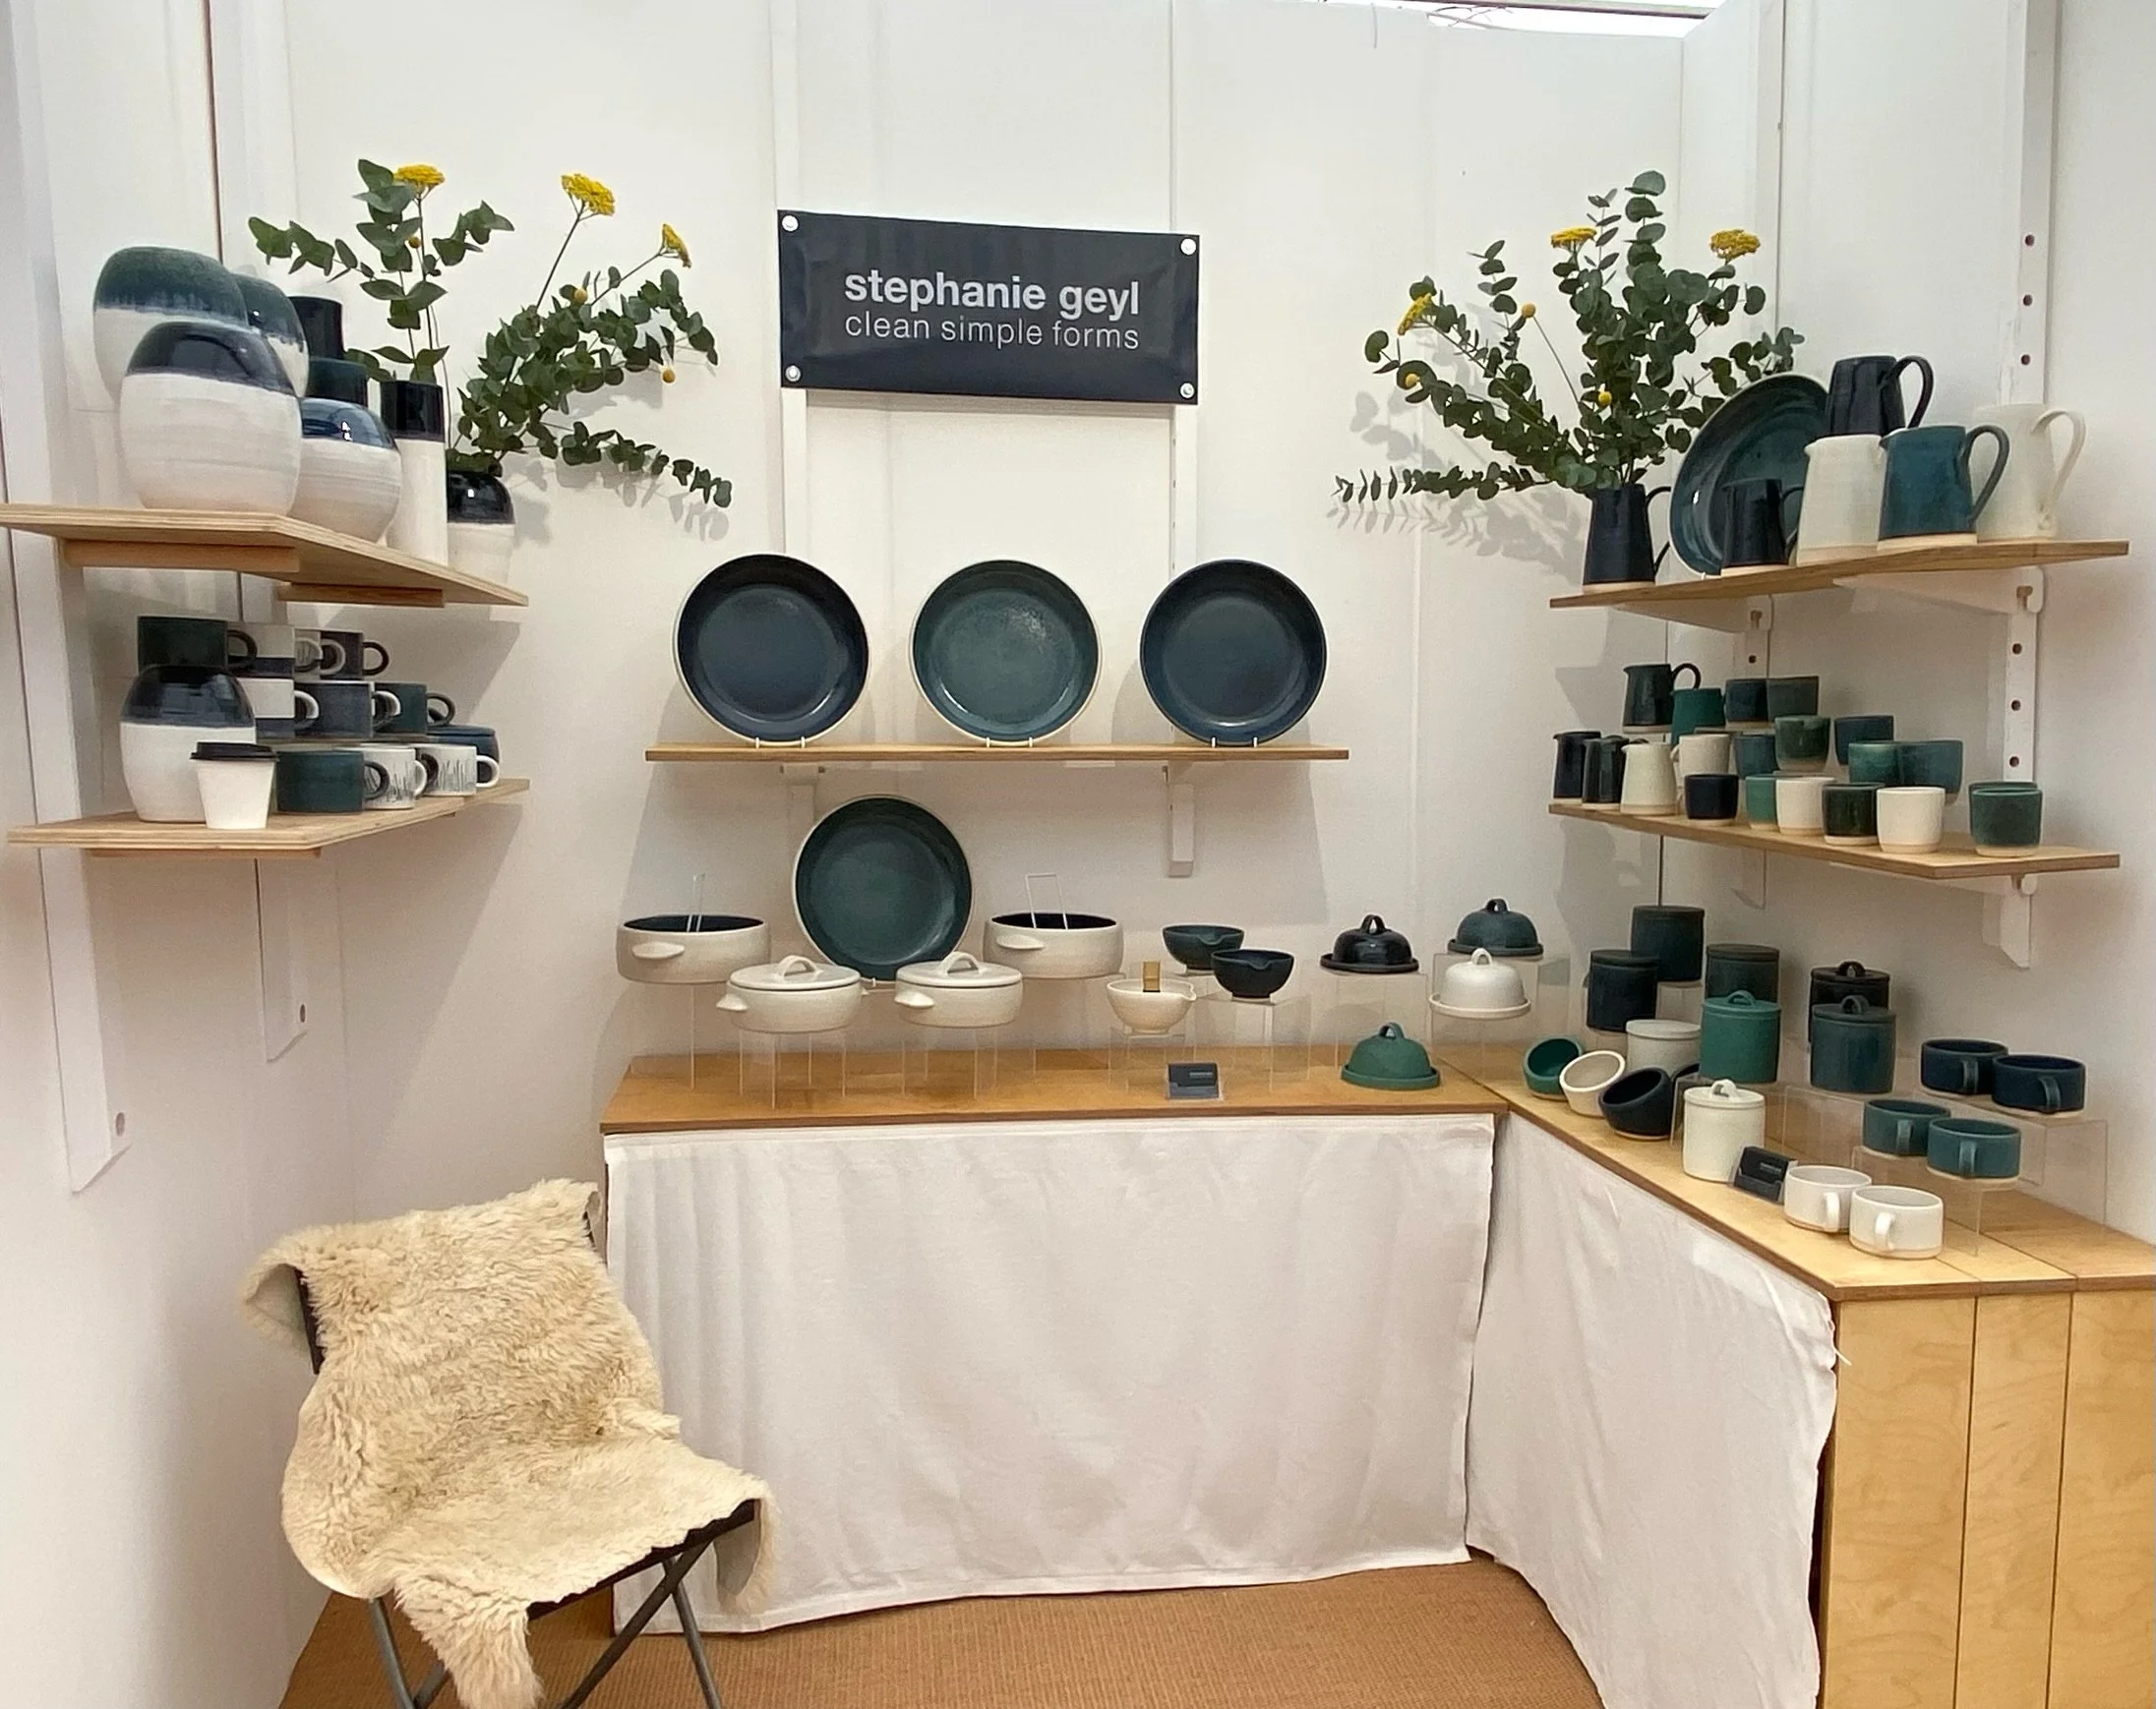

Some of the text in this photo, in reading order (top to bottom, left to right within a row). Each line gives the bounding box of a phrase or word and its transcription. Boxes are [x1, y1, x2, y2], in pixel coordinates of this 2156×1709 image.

[844, 268, 1140, 321] stephanie geyl
[845, 311, 1139, 350] clean simple forms
